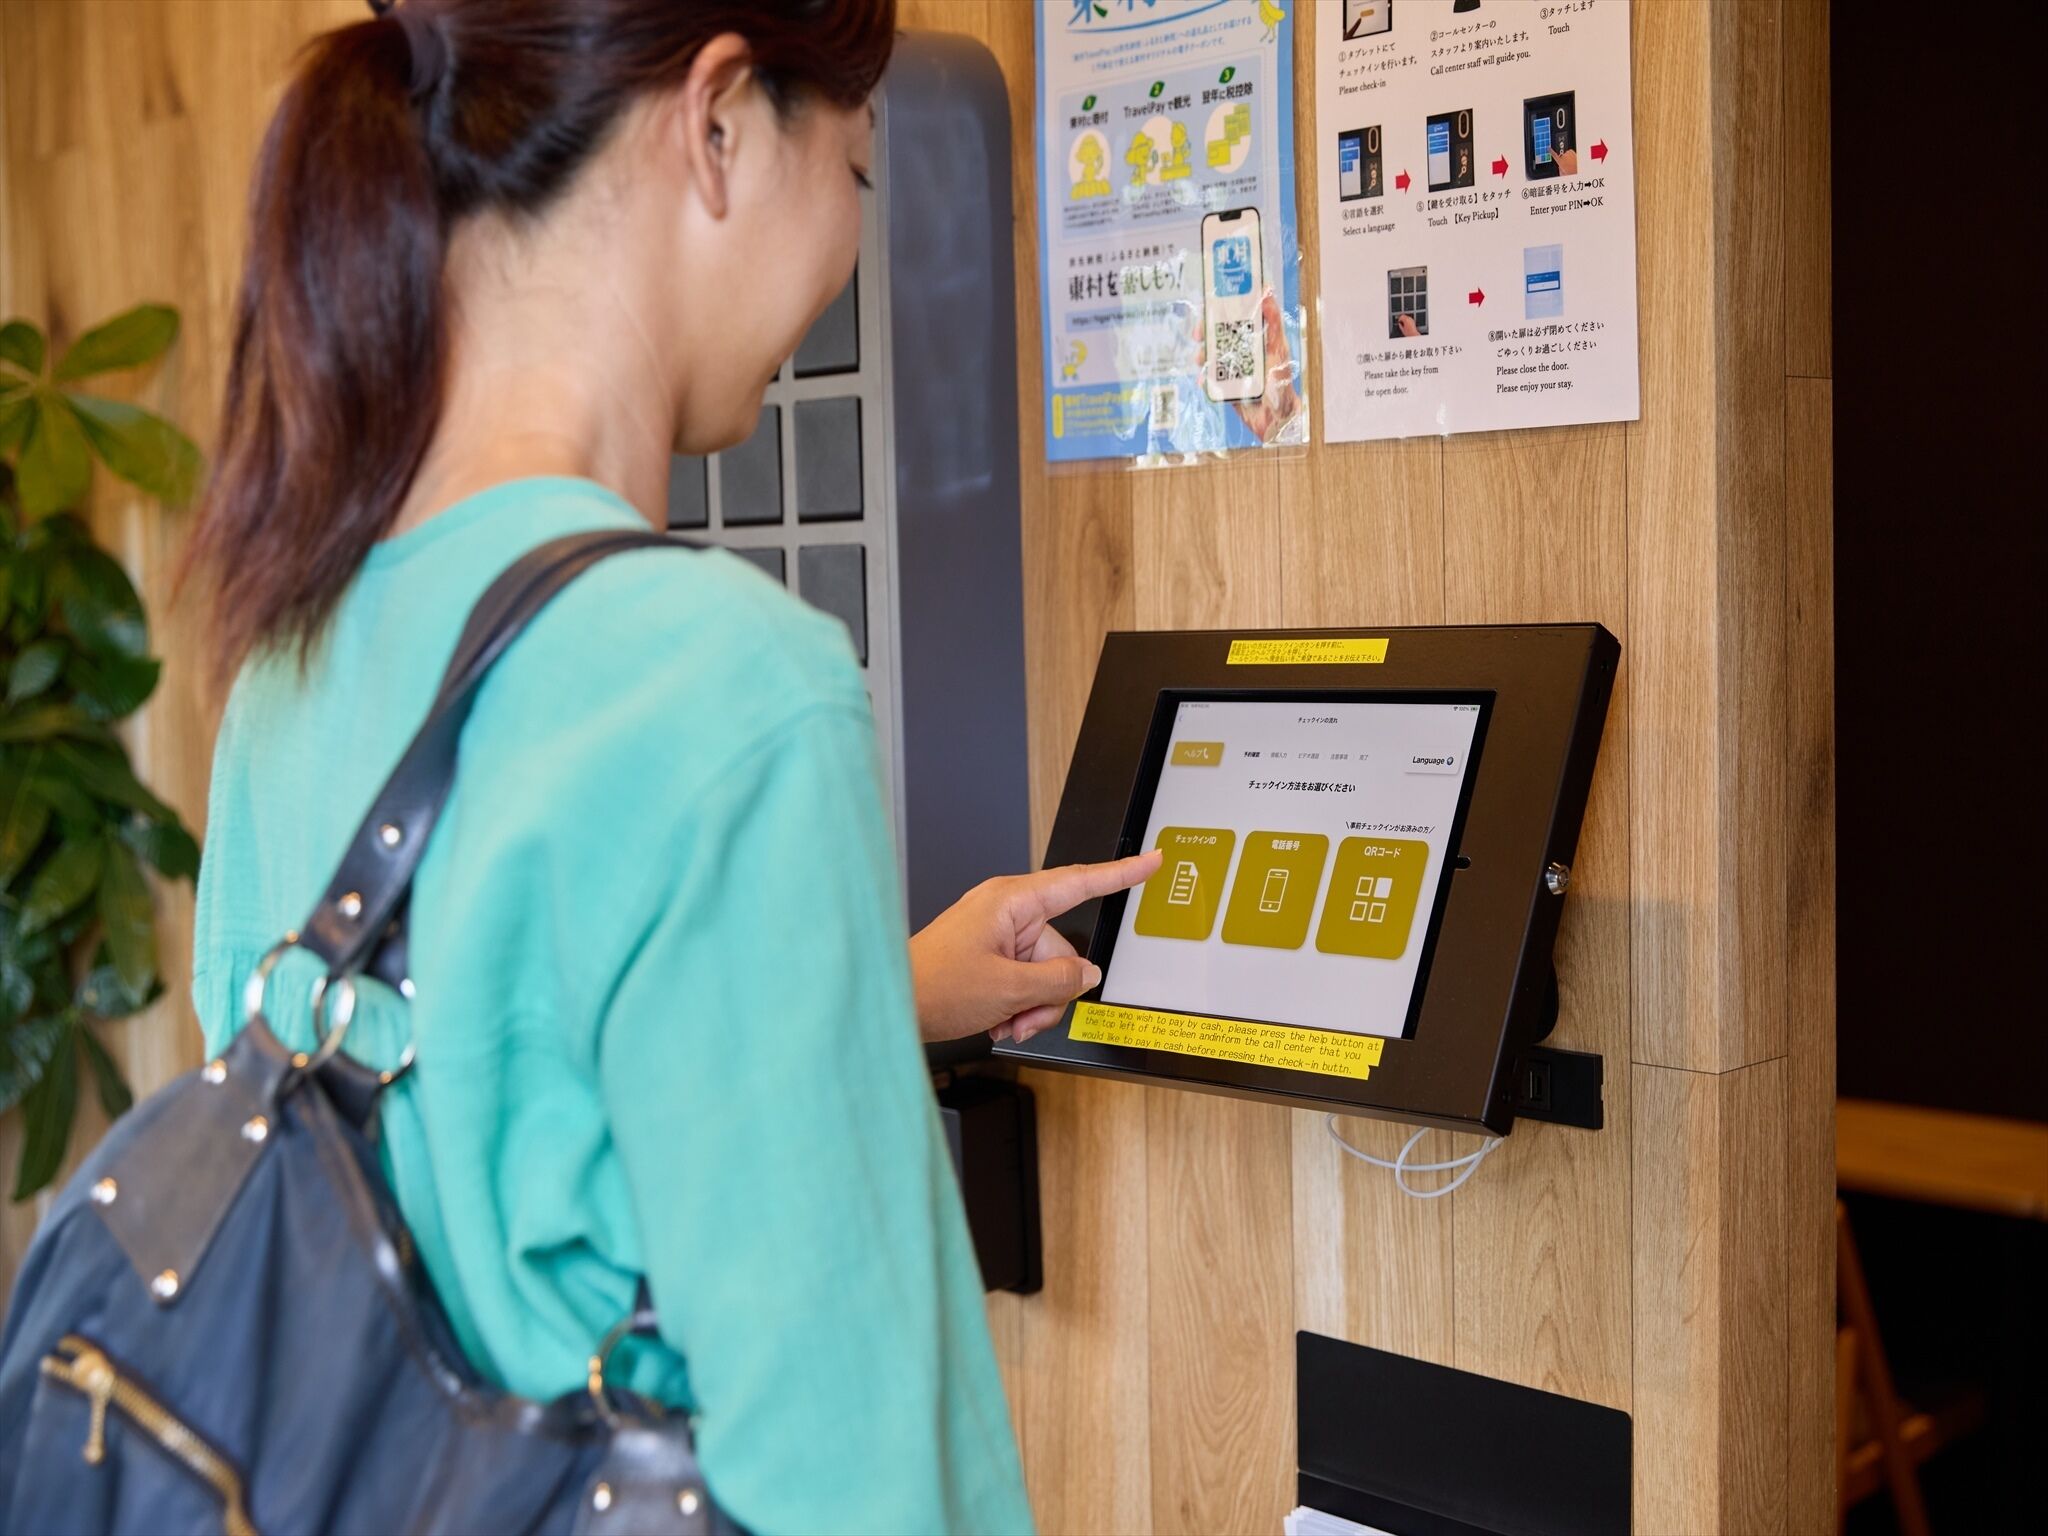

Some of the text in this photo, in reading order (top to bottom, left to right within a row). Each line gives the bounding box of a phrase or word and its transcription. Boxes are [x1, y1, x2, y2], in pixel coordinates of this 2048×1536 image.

[1548, 23, 1570, 35] Touch
[1431, 30, 1528, 58] スタッフより案内いたします。
[1339, 55, 1417, 78] チェックインを行います。
[1430, 51, 1531, 75] Call center staff will guide you.
[1338, 79, 1386, 95] Please check-in
[1530, 206, 1549, 215] Enter
[1551, 204, 1567, 215] your
[1428, 216, 1448, 227] Touch
[1343, 226, 1361, 236] Select
[1367, 223, 1395, 233] language
[1497, 340, 1597, 357] ごゆっくりお過ごしください
[1364, 365, 1439, 380] Please take the key from
[1496, 361, 1569, 375] Please close the door.
[1365, 385, 1409, 398] the open door.
[1496, 381, 1573, 393] Please enjoy your stay.
[1184, 749, 1203, 758] ヘルプ
[1412, 756, 1445, 766] Language
[1248, 780, 1356, 792] チェックイン方法をお選びください
[1175, 834, 1217, 845] チェックインID
[1271, 839, 1300, 851] 電話番号
[1364, 846, 1401, 858] QRコード
[1087, 1006, 1380, 1051] Guests who wish to pay by cash, please press the help button at
[1085, 1017, 1099, 1026] the
[1102, 1019, 1116, 1029] top
[1120, 1021, 1135, 1031] left
[1138, 1023, 1149, 1033] of
[1151, 1026, 1166, 1036] the
[1245, 1036, 1260, 1047] the
[1262, 1039, 1281, 1050] call
[1283, 1043, 1315, 1054] center
[1319, 1046, 1341, 1058] that
[1344, 1051, 1362, 1061] you
[1081, 1030, 1352, 1075] would like to pay in cash before pressing the check-in buttn.
